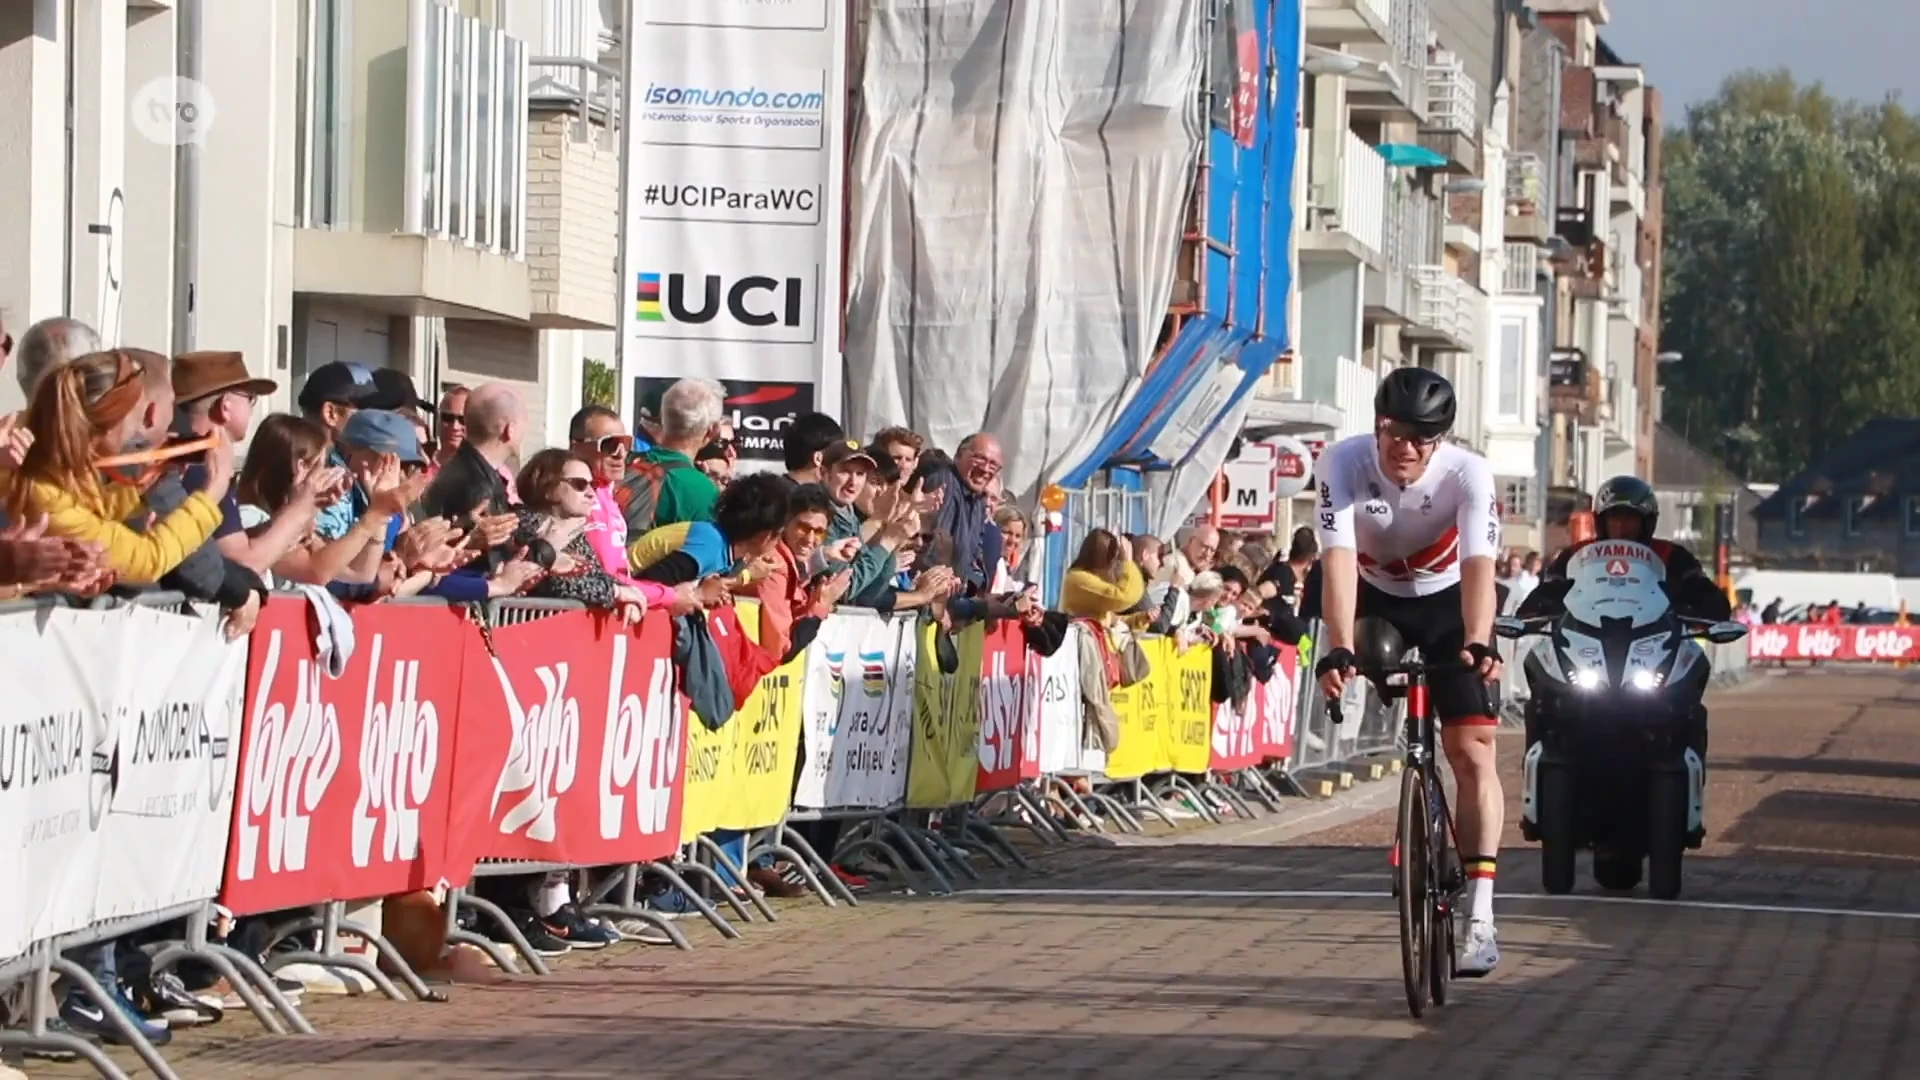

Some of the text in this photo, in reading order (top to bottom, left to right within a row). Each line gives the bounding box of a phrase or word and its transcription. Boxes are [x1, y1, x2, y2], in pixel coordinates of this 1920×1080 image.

[645, 83, 822, 109] isomundo.com
[642, 111, 820, 128] International Sports Organisation
[644, 184, 814, 211] #UCIParaWC
[668, 273, 802, 327] UCI
[1237, 488, 1257, 506] M
[1593, 544, 1653, 562] YAMAHA
[1609, 560, 1625, 574] A
[1855, 627, 1913, 657] lotto
[599, 634, 680, 840] lotto
[238, 629, 342, 881] lotto
[352, 634, 438, 868] lotto
